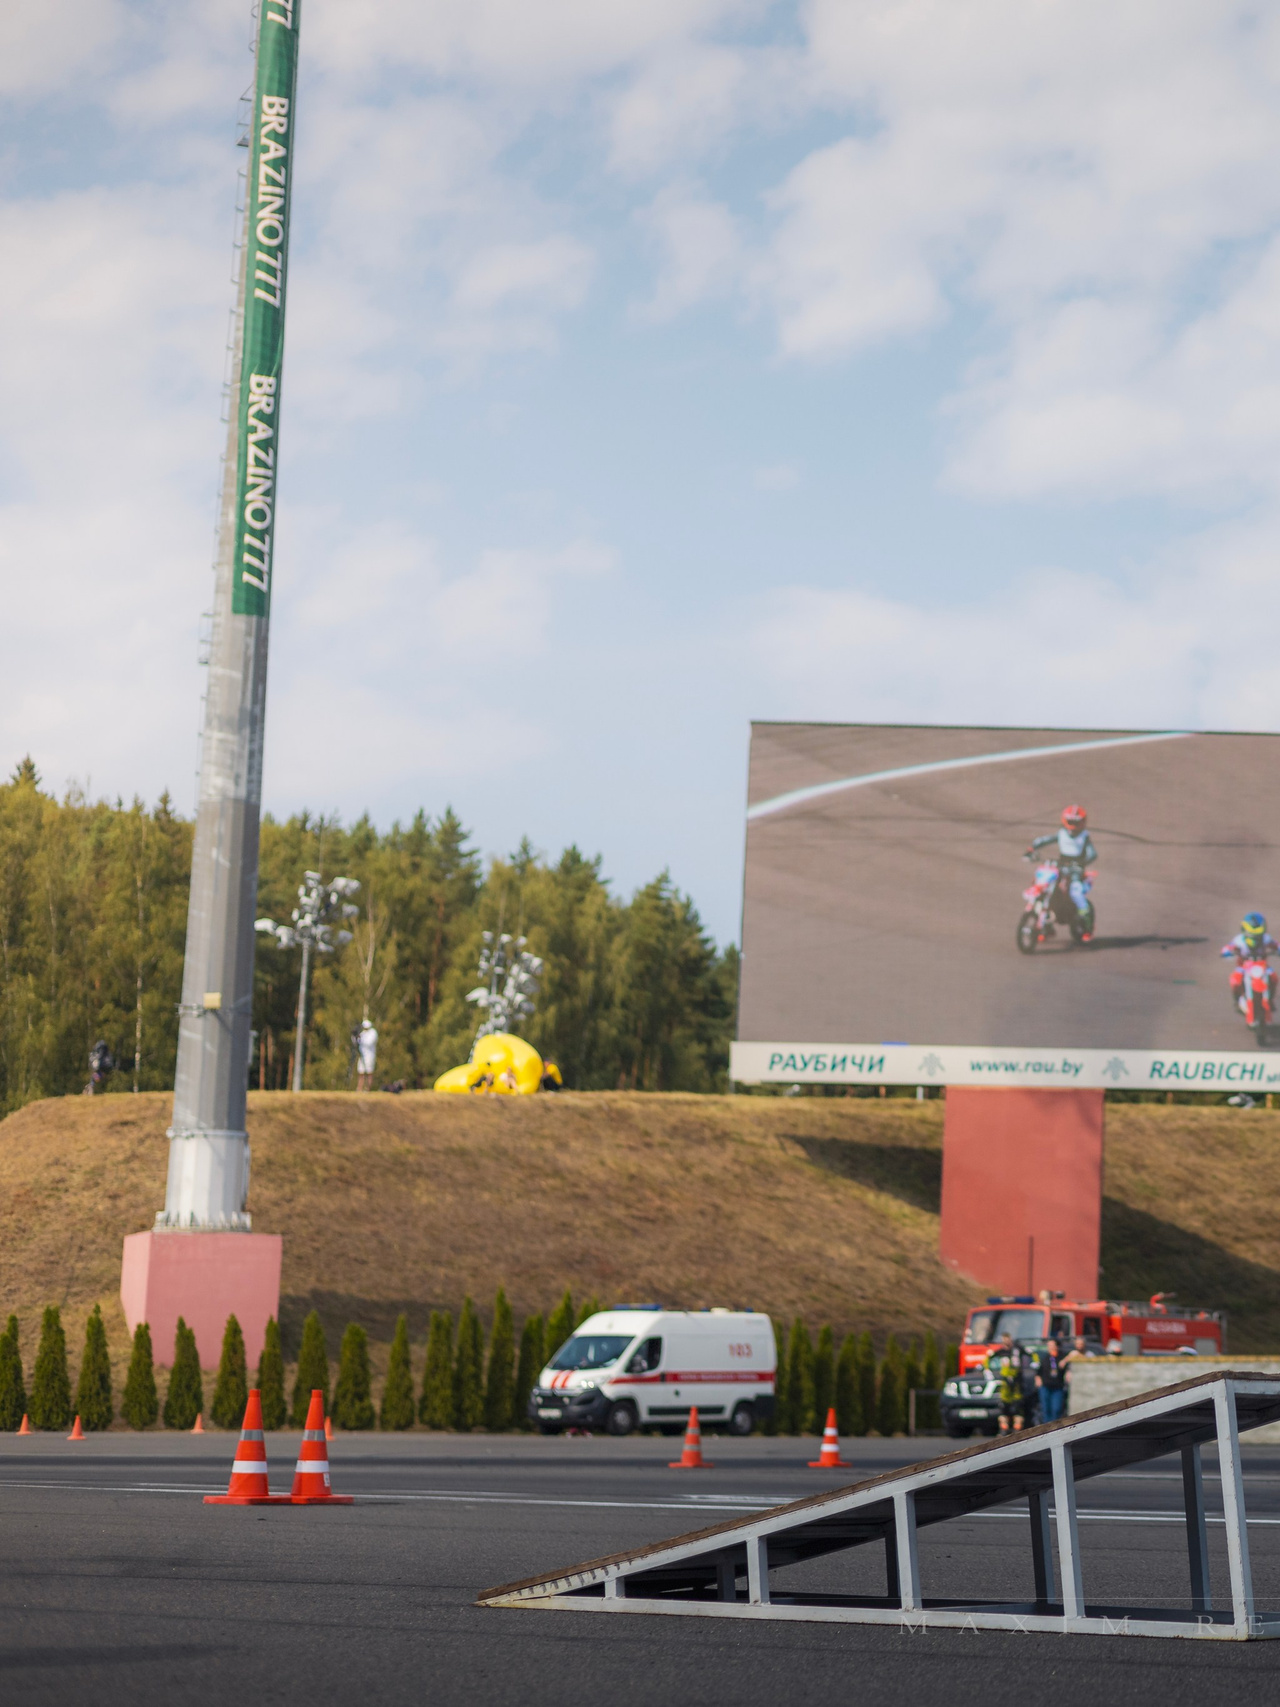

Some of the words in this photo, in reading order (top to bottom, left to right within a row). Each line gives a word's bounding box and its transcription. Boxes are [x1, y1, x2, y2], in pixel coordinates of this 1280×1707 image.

[769, 1053, 885, 1073] РАУБИЧИ
[970, 1058, 1083, 1077] www.rau.by
[1150, 1061, 1265, 1081] RAUBICHI
